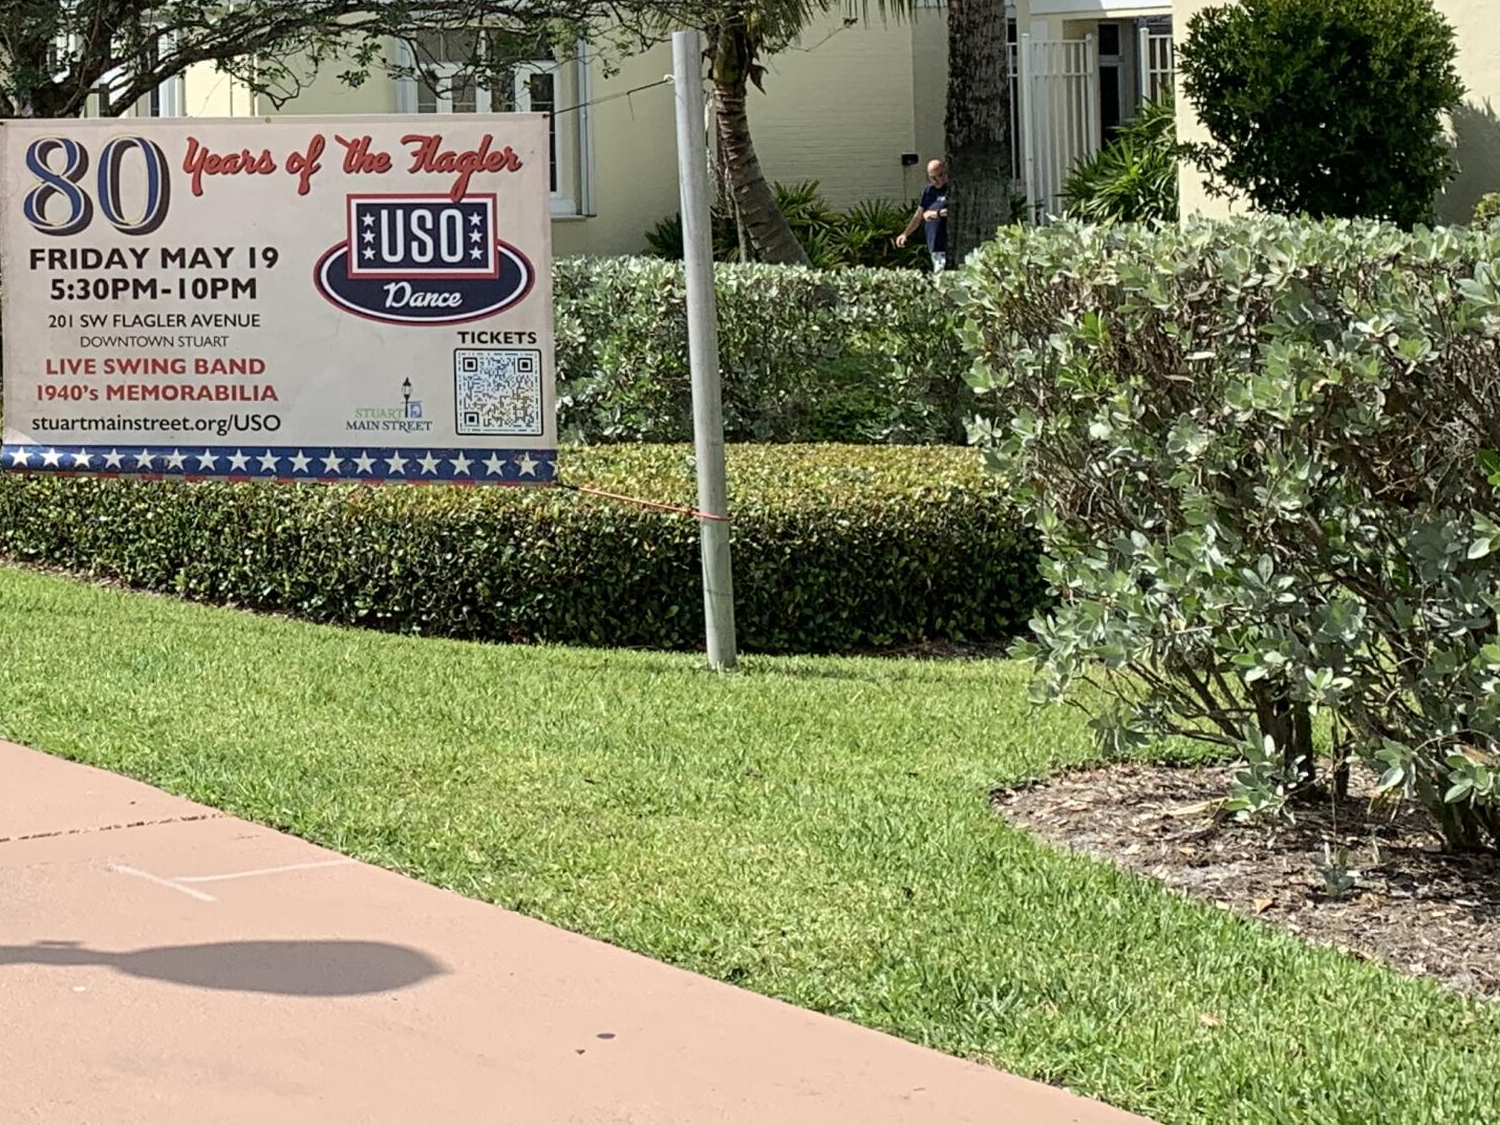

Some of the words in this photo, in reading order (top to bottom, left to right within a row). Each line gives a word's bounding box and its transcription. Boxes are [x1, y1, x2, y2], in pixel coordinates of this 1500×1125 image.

[23, 135, 171, 236] 80
[183, 136, 277, 197] Years
[285, 133, 326, 196] of
[334, 135, 393, 174] the
[400, 133, 523, 203] Flagler
[380, 208, 464, 264] USO
[30, 247, 151, 270] FRIDAY
[161, 247, 235, 269] MAY
[249, 247, 280, 269] 19
[50, 277, 257, 300] 5:30PM-10PM
[383, 281, 463, 308] Dance
[48, 315, 73, 328] 201
[80, 315, 109, 327] SW
[113, 314, 186, 328] FLAGLER
[190, 314, 260, 327] AVENUE
[80, 336, 174, 348] DOWNTOWN
[178, 336, 229, 348] STUART
[457, 331, 537, 344] TICKETS
[45, 358, 96, 375] LIVE
[103, 358, 186, 375] SWING
[194, 358, 266, 375] BAND
[106, 385, 279, 402] MEMORABILIA
[356, 408, 403, 419] STUART
[32, 414, 281, 437] stuartmainstreet.org/USO
[346, 420, 379, 430] MAIN
[382, 420, 432, 433] STREET
